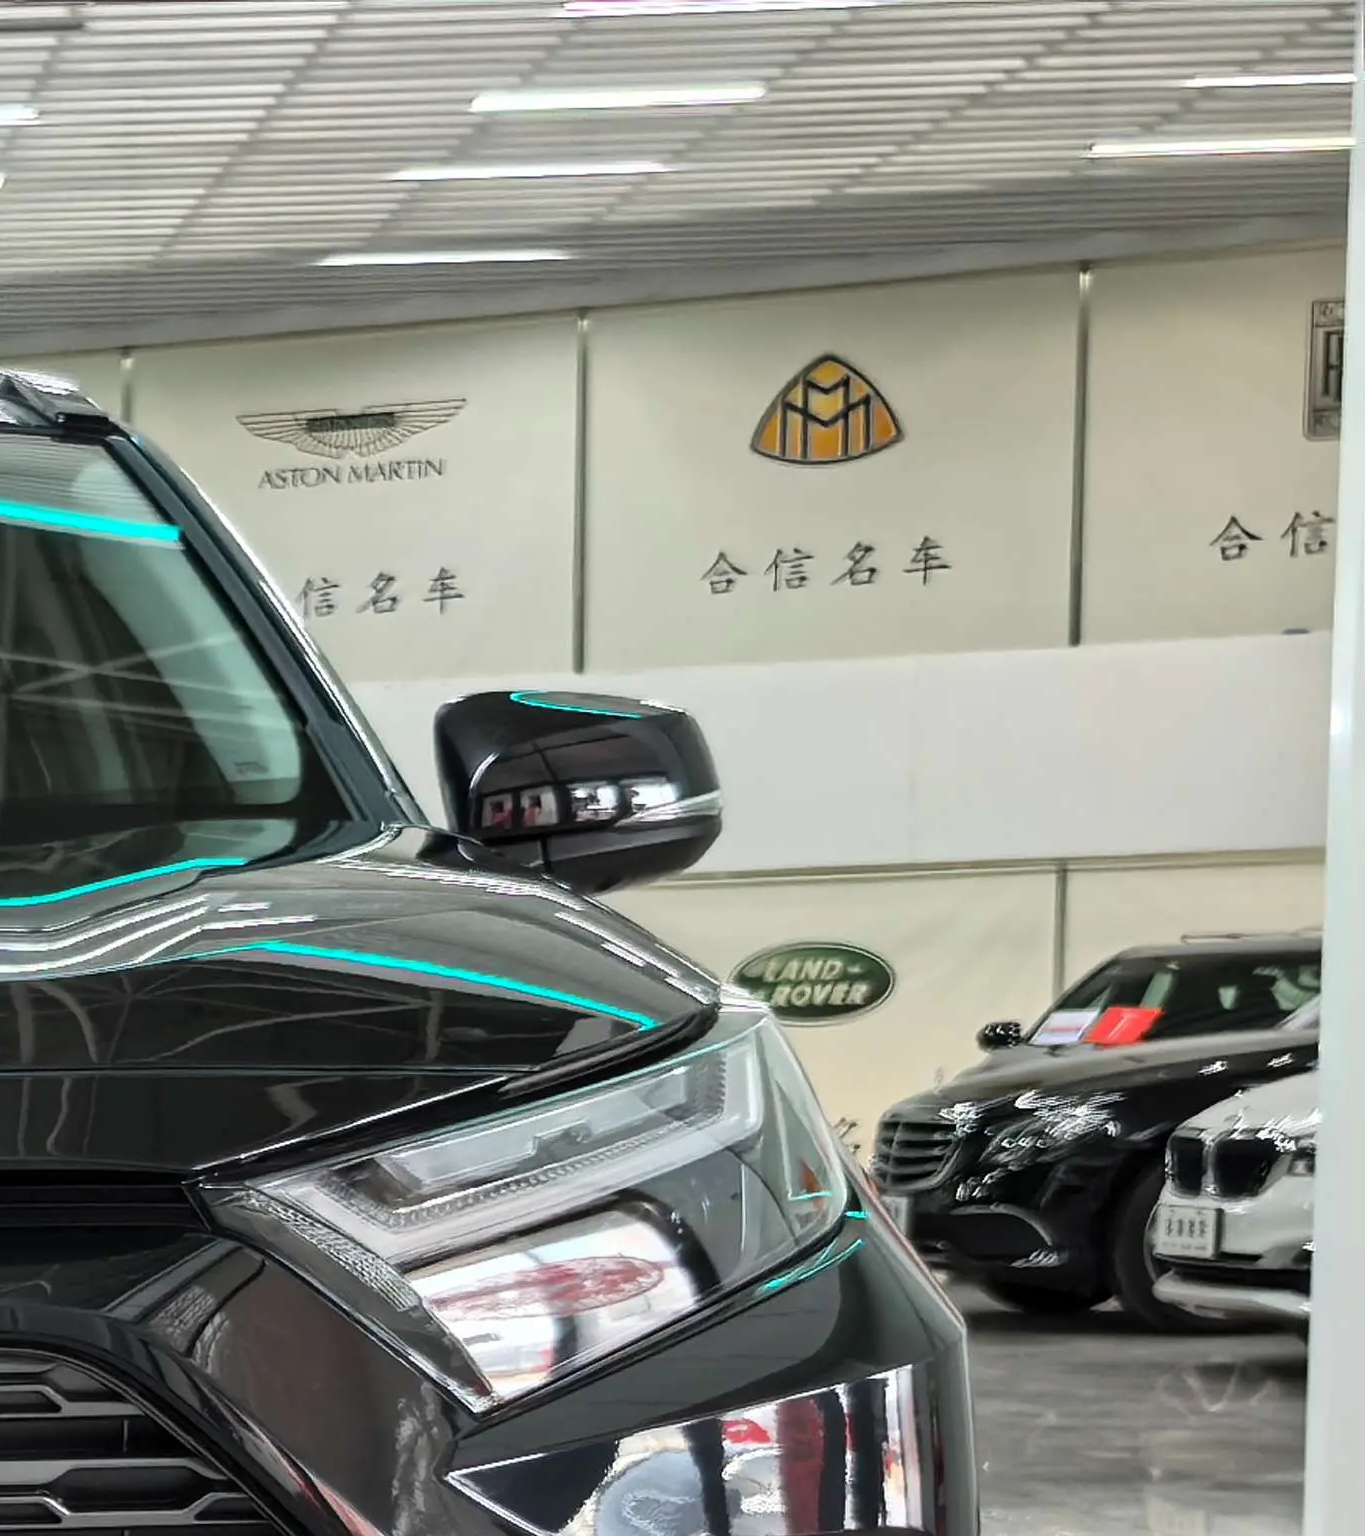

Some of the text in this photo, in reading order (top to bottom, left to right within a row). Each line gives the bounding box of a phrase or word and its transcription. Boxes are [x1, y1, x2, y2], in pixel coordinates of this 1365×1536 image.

[258, 457, 447, 490] ASTON MARTIN
[700, 535, 952, 594] 合信名车
[762, 956, 845, 983] LAND
[771, 981, 871, 1008] ROVER
